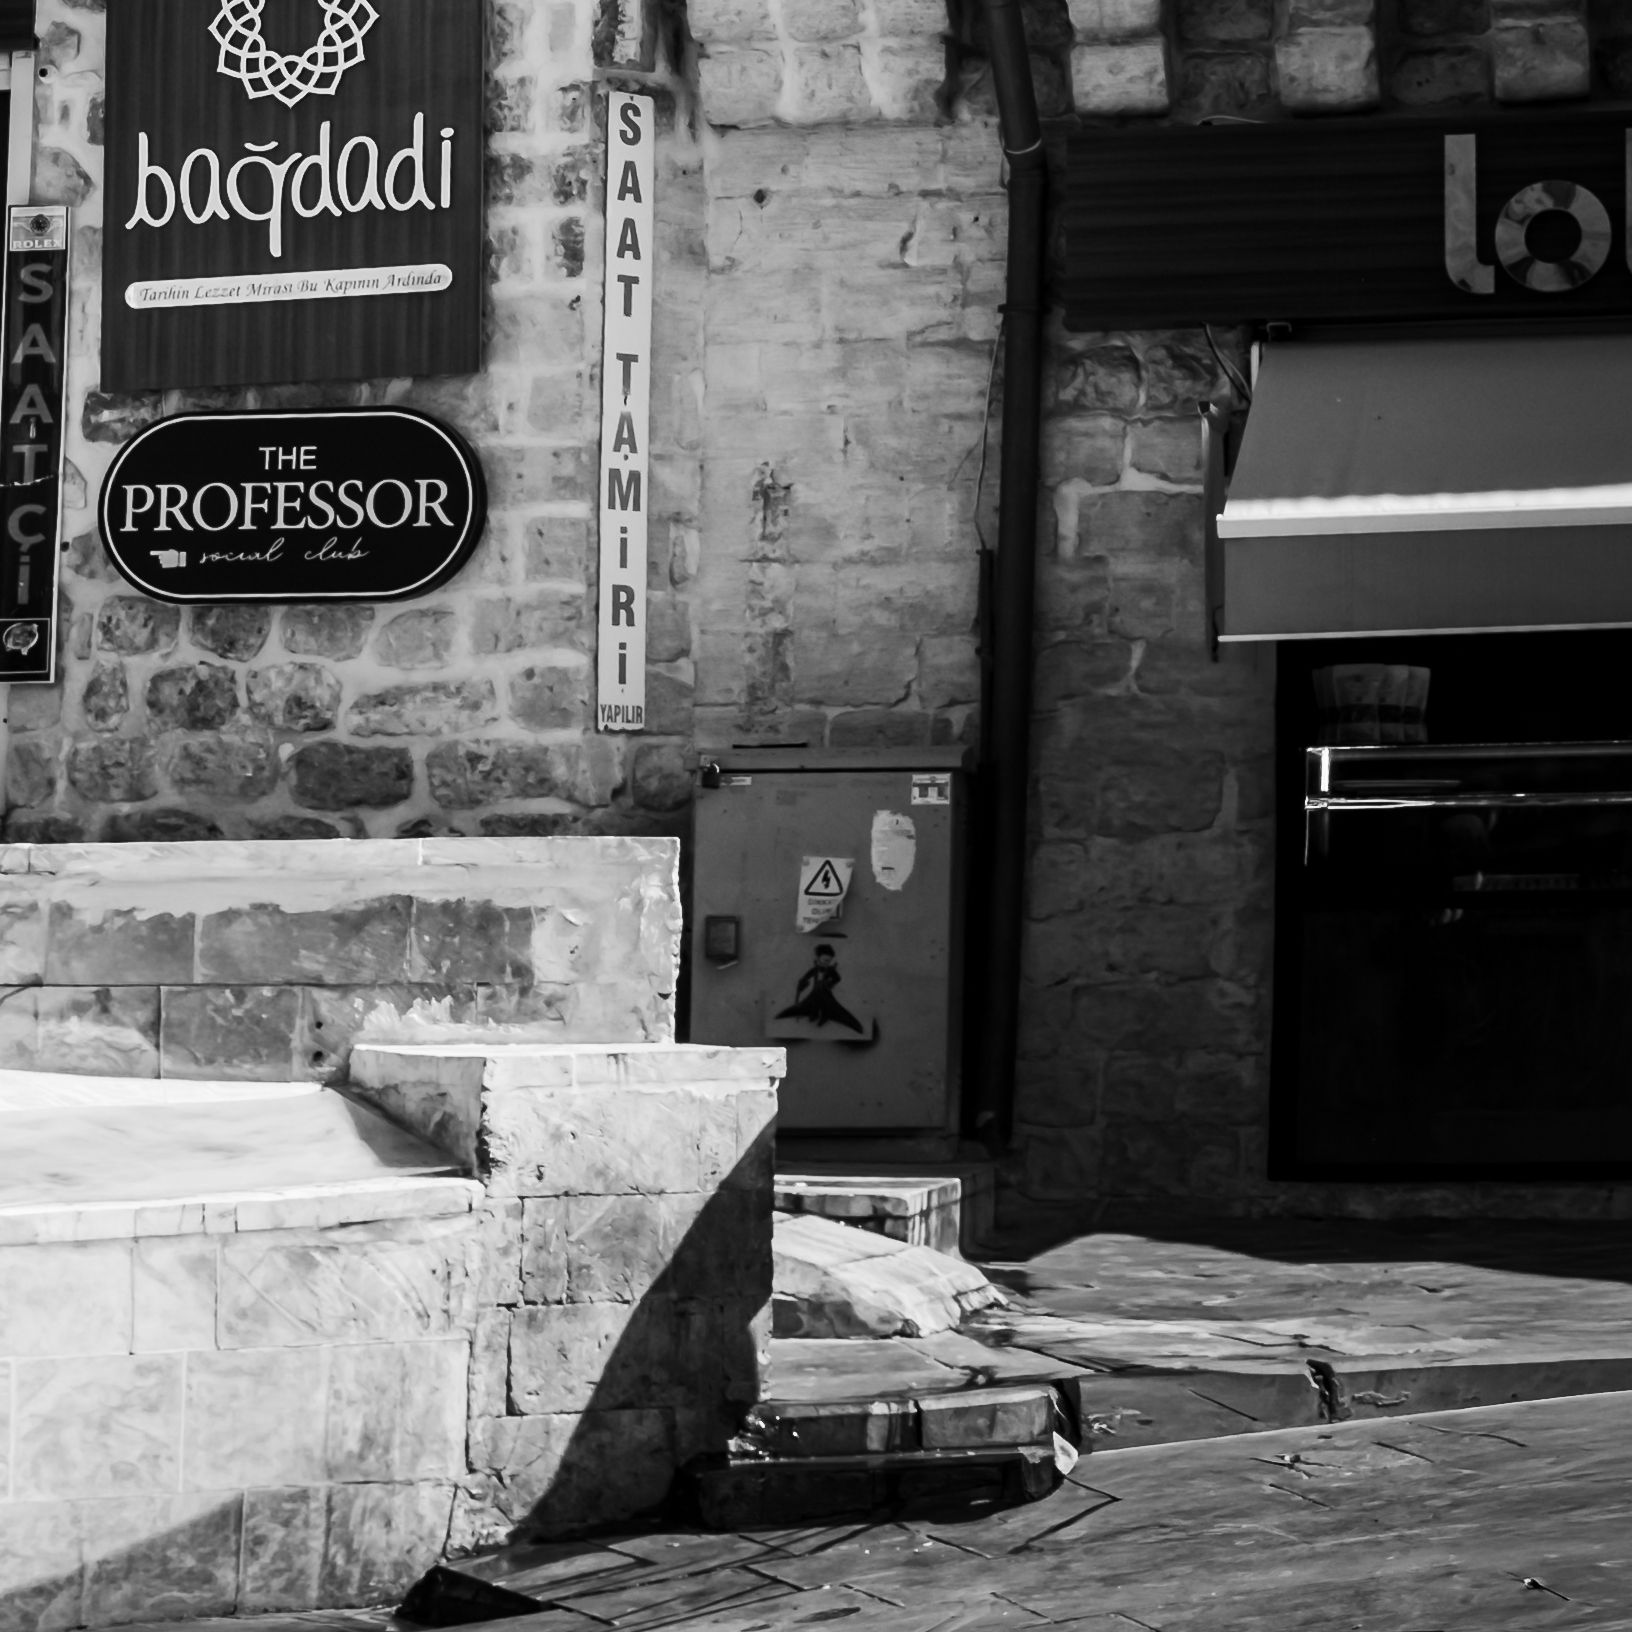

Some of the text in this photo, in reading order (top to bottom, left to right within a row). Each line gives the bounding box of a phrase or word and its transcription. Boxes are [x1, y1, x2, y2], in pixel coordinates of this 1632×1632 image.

[125, 112, 455, 258] bağdadi
[616, 102, 642, 317] SAAT
[1444, 128, 1632, 295] lo
[13, 238, 62, 250] ROLEX
[194, 285, 241, 299] Lezzet
[297, 279, 318, 292] Bu
[8, 263, 56, 604] SAATÇİ
[259, 445, 317, 470] THE
[119, 479, 455, 532] PROFESSOR
[199, 537, 371, 564] social club
[600, 704, 643, 724] YAPILIR
